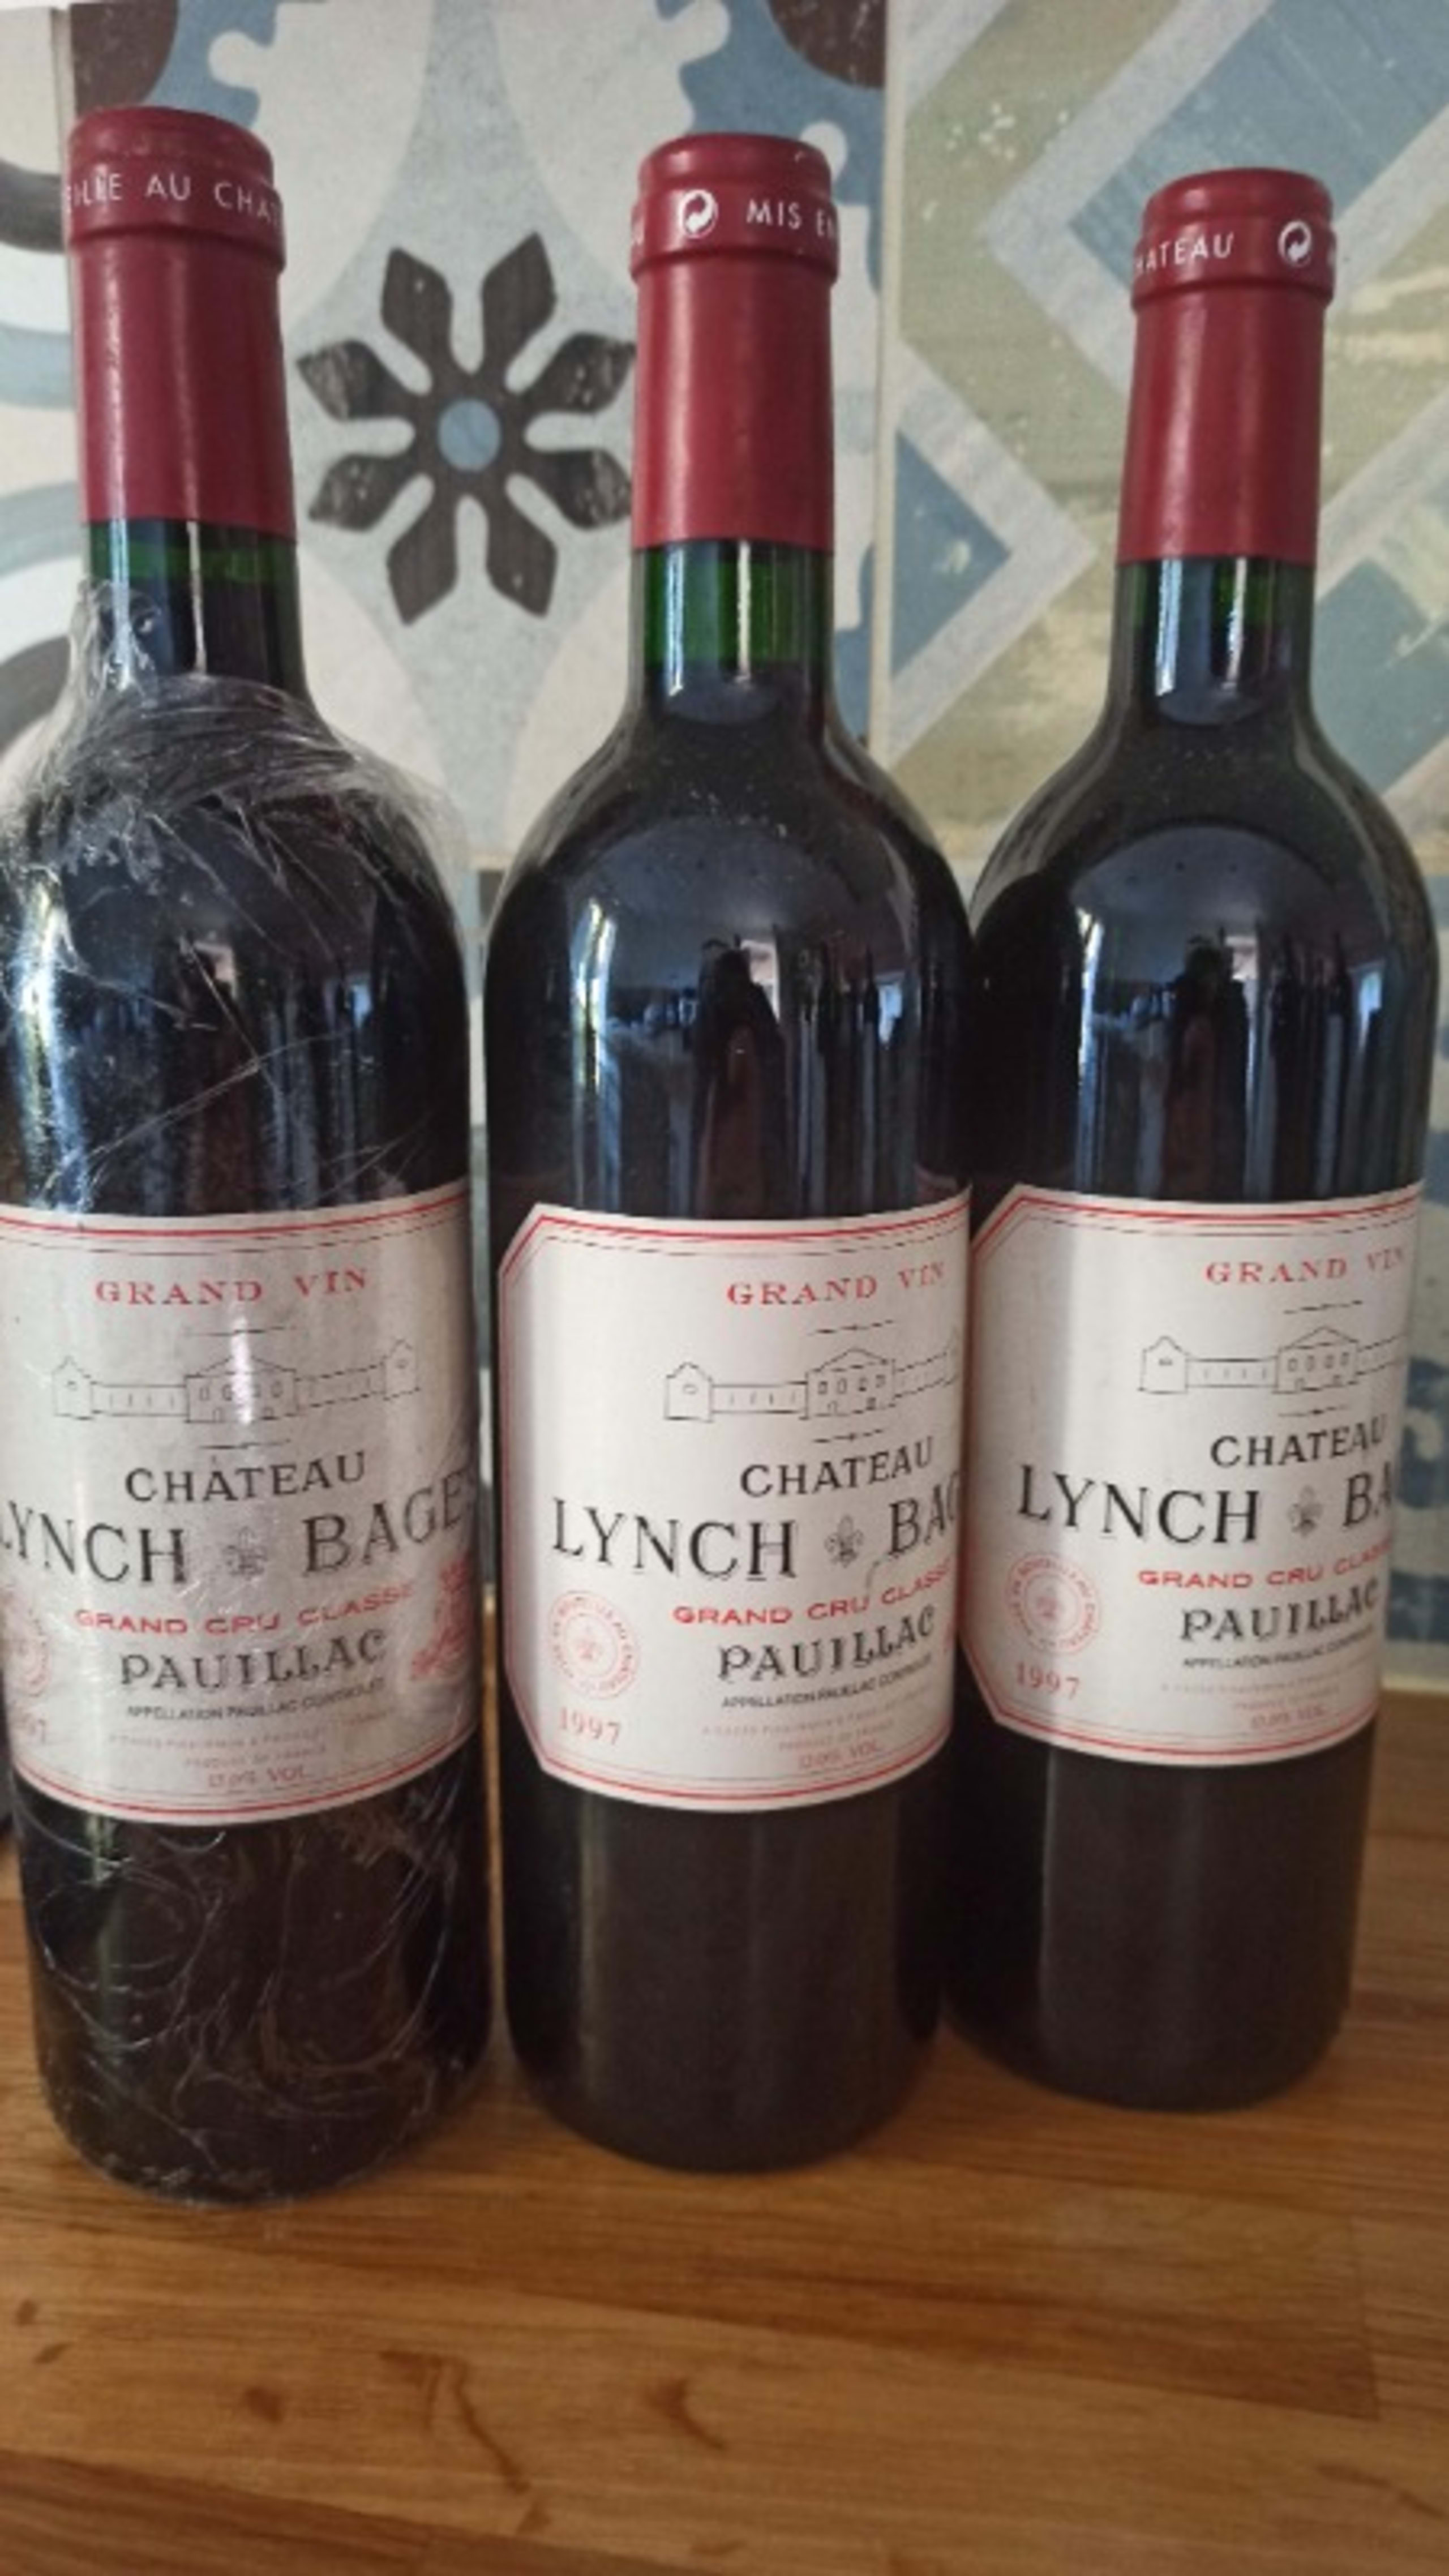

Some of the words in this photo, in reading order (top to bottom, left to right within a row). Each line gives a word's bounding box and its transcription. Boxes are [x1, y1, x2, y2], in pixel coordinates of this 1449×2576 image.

[146, 172, 191, 202] AU
[746, 198, 802, 230] MIS
[95, 1279, 263, 1306] GRAND
[294, 1267, 368, 1298] VIN
[726, 1274, 877, 1306] GRAND
[897, 1261, 945, 1289] VIN
[1204, 1258, 1347, 1284] GRAND
[1210, 1413, 1386, 1468] CHATEAU
[740, 1435, 933, 1498] CHATEAU
[302, 1471, 471, 1574] BAGE
[1017, 1464, 1260, 1545] LYNCH
[551, 1497, 798, 1579] LYNCH
[1138, 1569, 1254, 1589] GRAND
[1265, 1565, 1324, 1587] CRU
[75, 1608, 188, 1635] GRAND
[204, 1613, 281, 1635] CRU
[672, 1606, 792, 1626] GRAND
[807, 1597, 870, 1622] CRU
[1180, 1576, 1379, 1641] PAUILLAC
[120, 1628, 387, 1690] PAUILLAC
[718, 1604, 935, 1682] PAUILLAC
[1016, 1660, 1080, 1700] 1997
[559, 1706, 620, 1746] 1997
